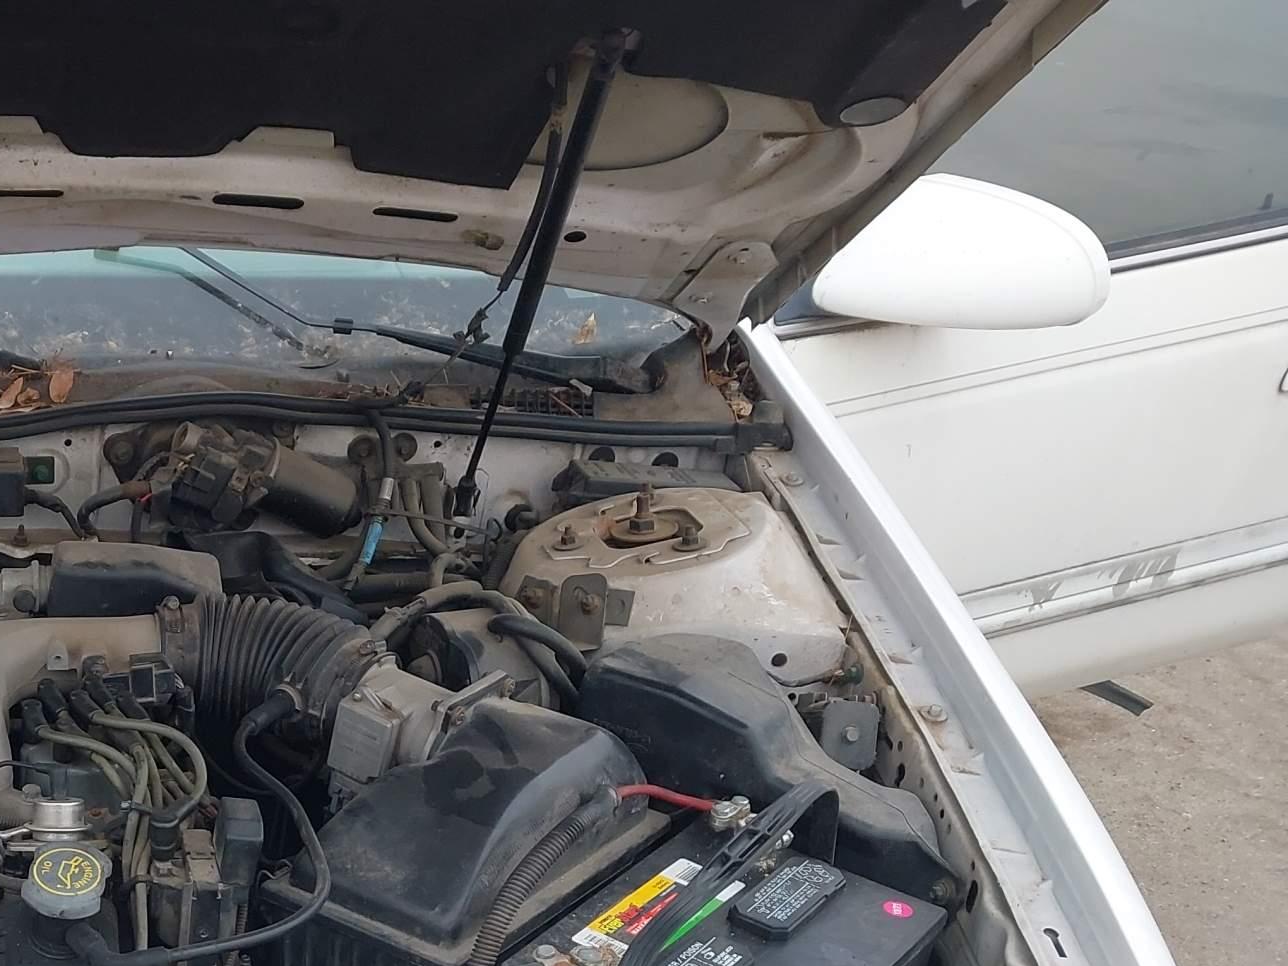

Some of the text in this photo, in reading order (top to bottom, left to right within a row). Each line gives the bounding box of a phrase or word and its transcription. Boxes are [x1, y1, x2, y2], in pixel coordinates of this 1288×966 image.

[41, 860, 53, 875] OIL
[72, 861, 93, 889] ENGINE
[680, 941, 704, 959] POISON
